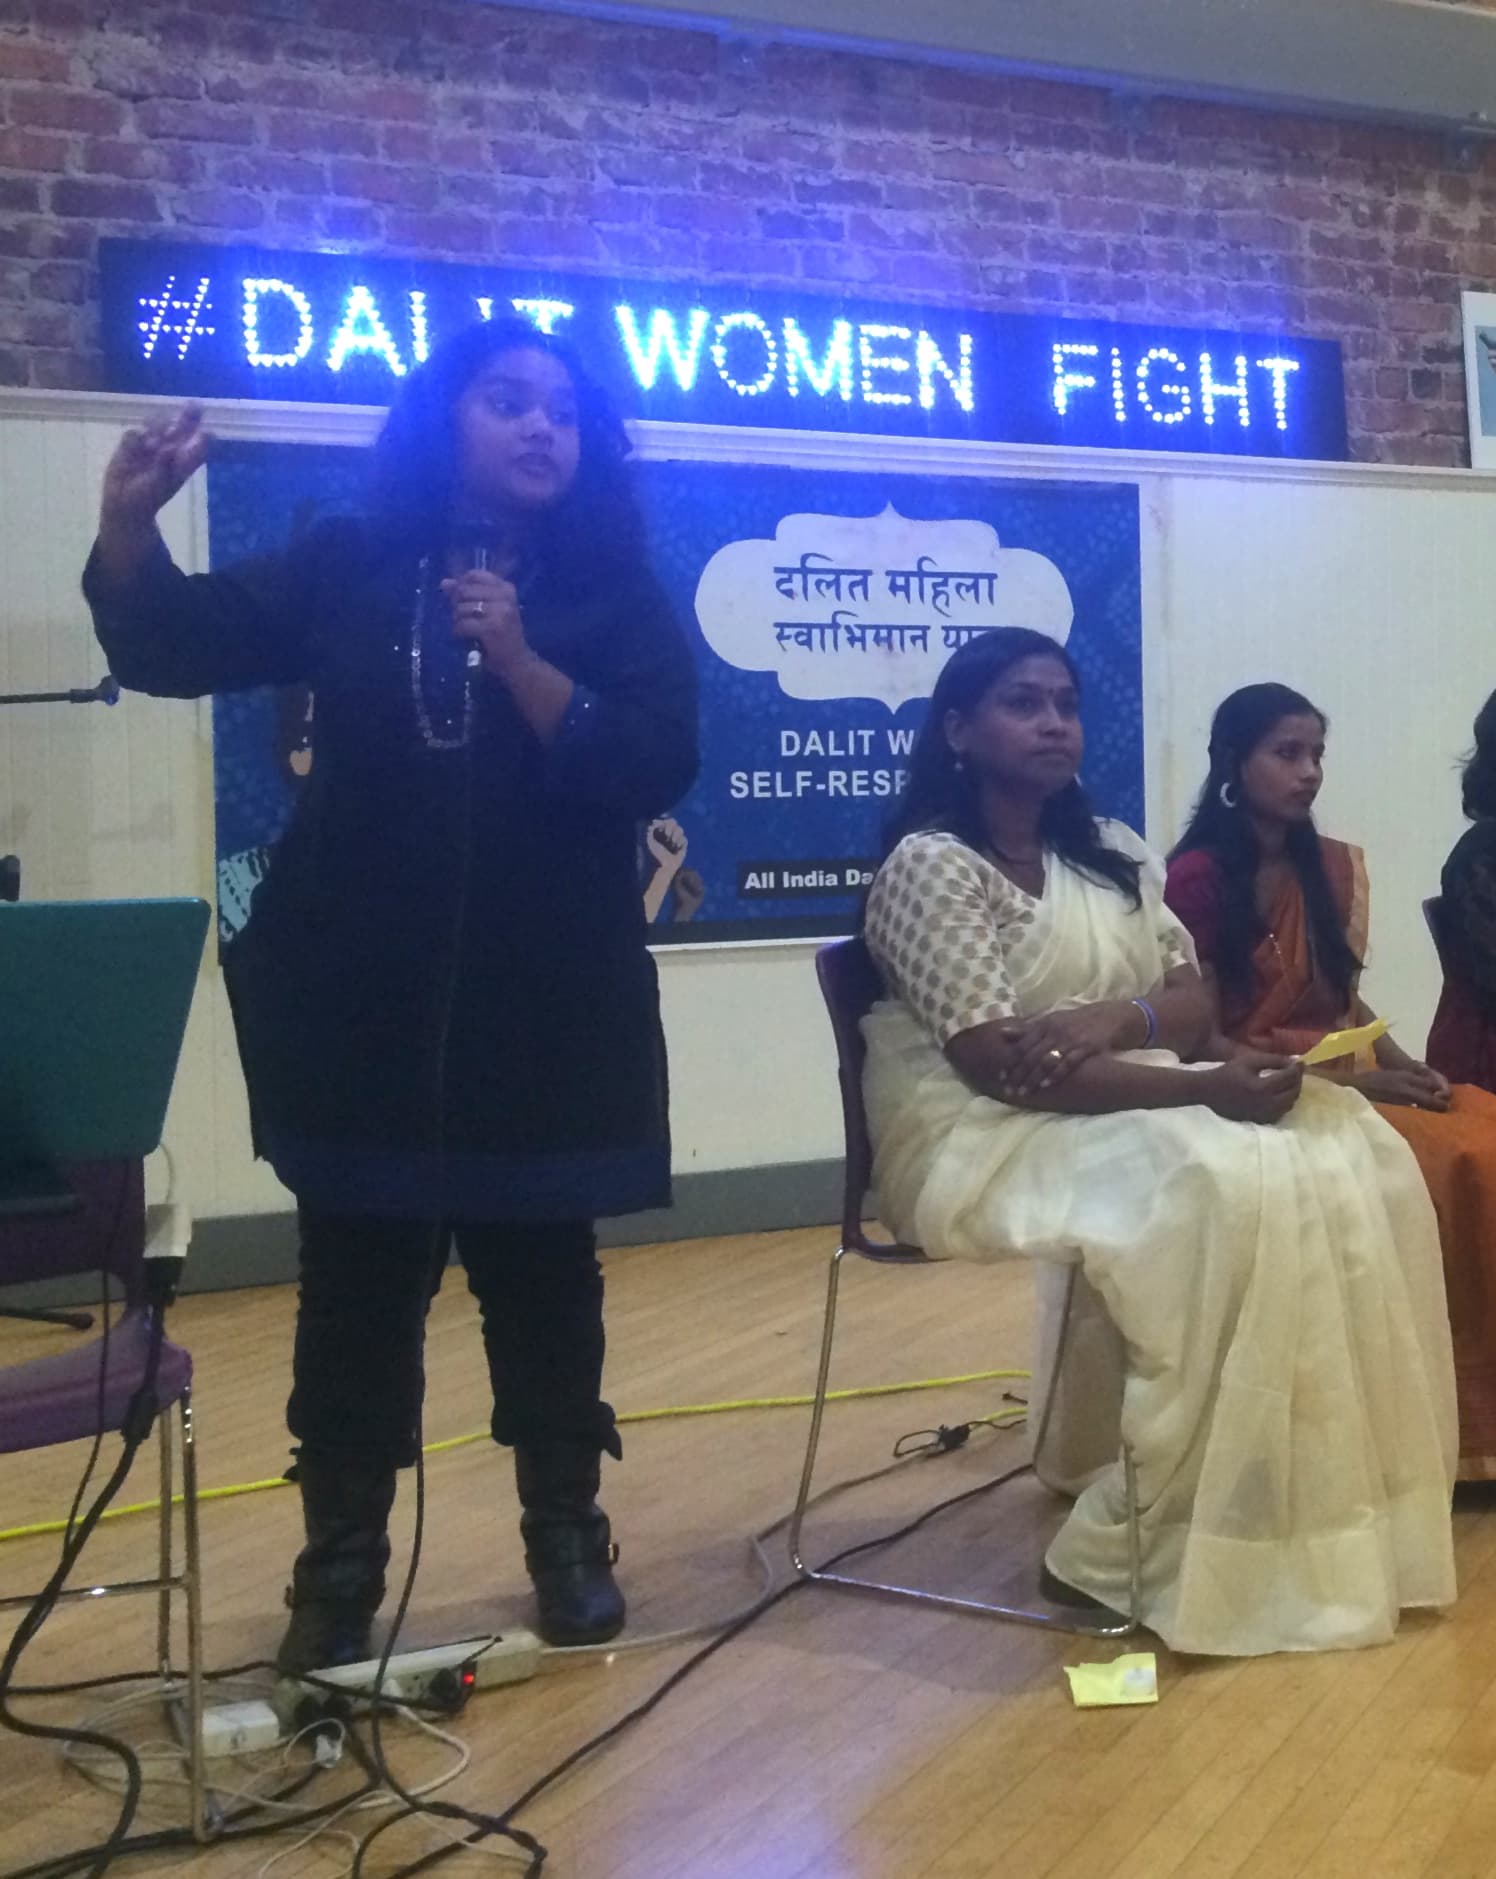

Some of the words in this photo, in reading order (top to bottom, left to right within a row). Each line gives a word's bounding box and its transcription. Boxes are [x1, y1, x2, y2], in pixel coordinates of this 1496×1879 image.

[614, 303, 976, 412] WOMEN
[1053, 343, 1300, 430] FIGHT
[774, 553, 873, 602] दलित
[886, 556, 998, 616] महिला
[774, 610, 931, 654] स्वाभिमान
[780, 729, 876, 757] DALIT
[744, 871, 776, 890] All
[782, 870, 839, 888] India
